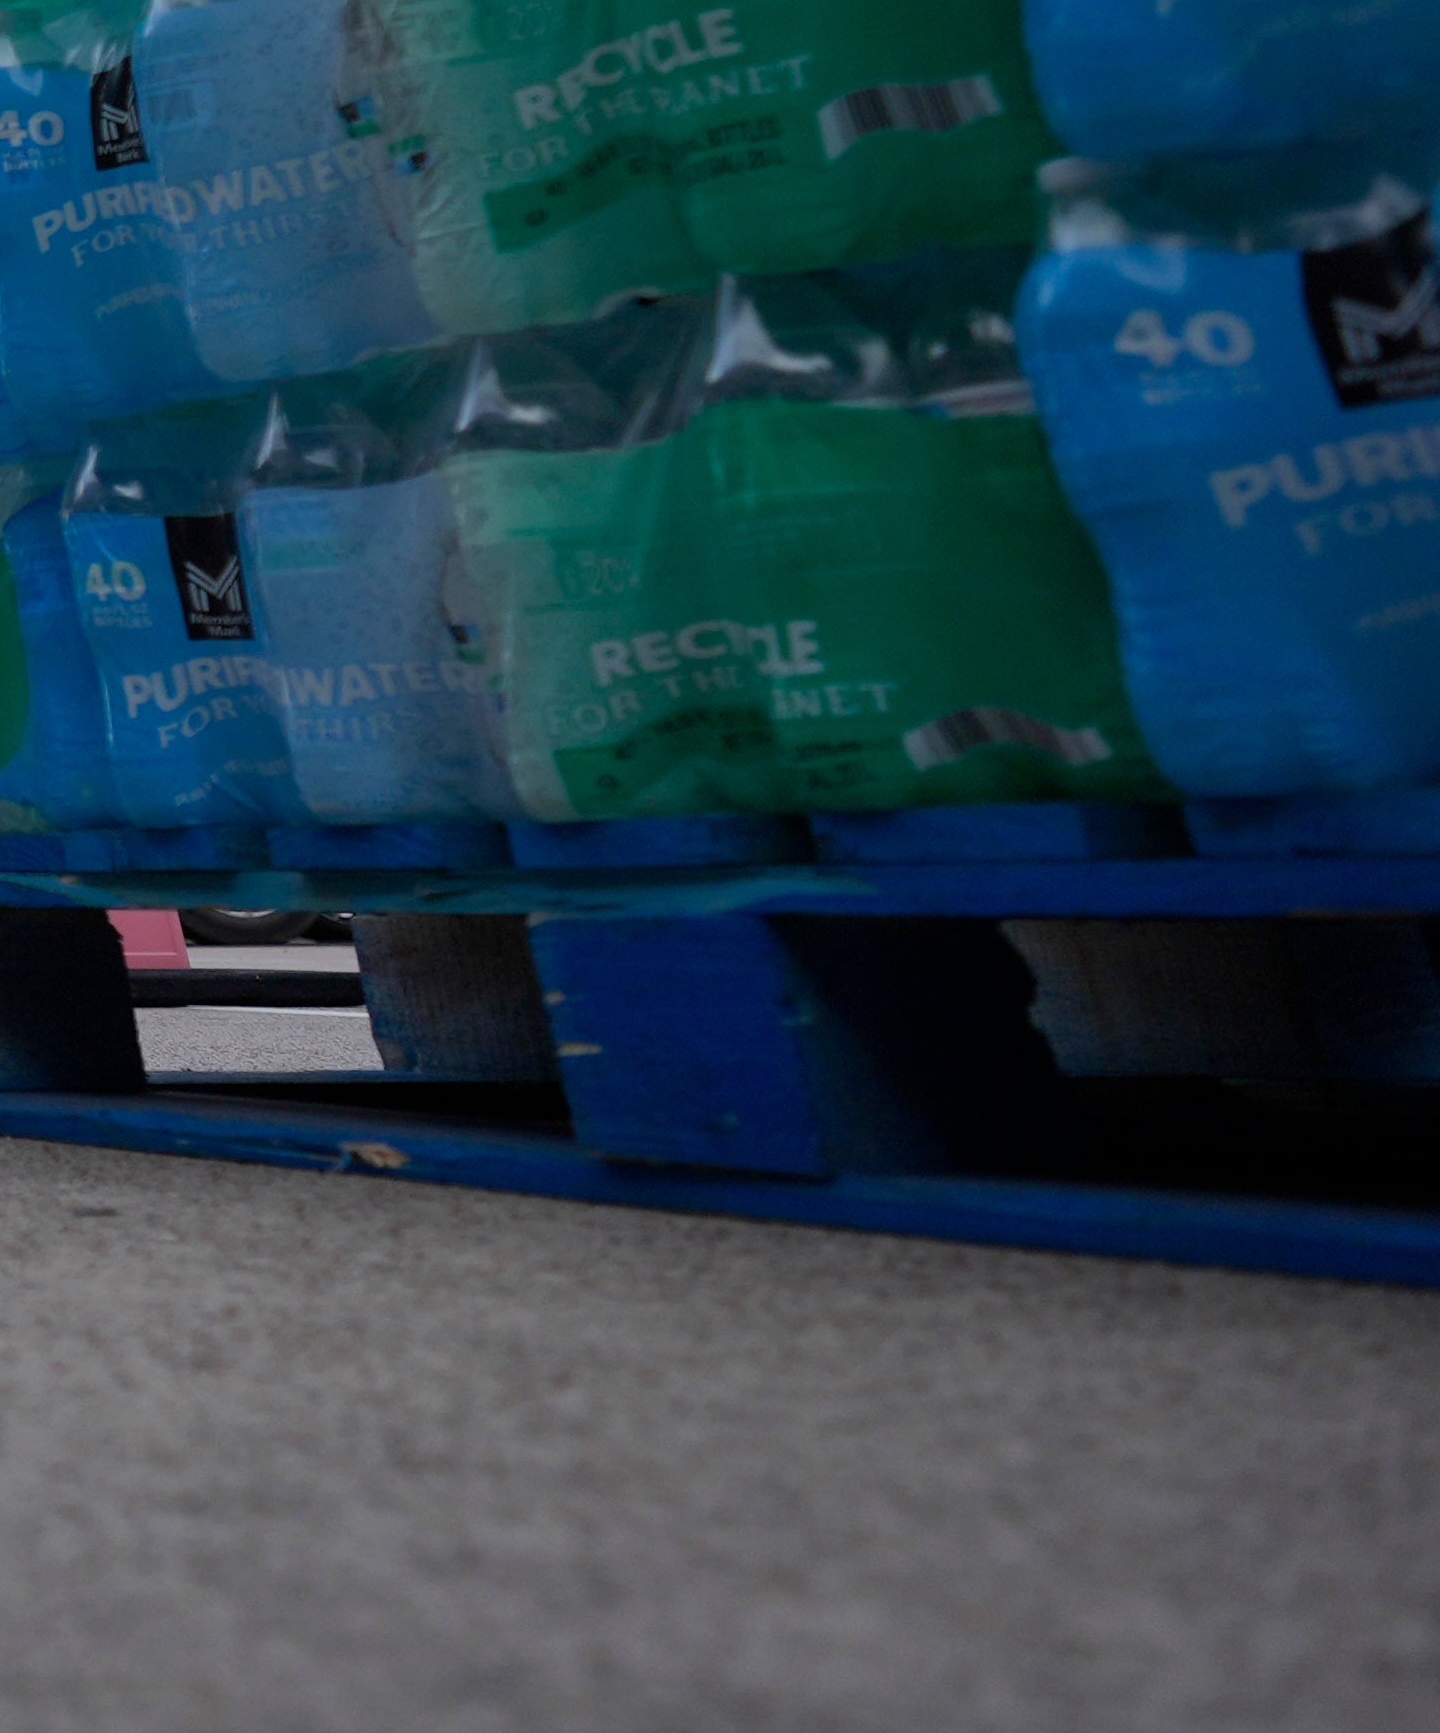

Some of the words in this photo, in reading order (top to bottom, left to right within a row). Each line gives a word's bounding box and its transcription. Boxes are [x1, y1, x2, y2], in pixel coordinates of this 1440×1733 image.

[192, 141, 375, 216] WATER
[479, 135, 568, 180] FOR
[70, 225, 134, 268] FOR
[1113, 309, 1254, 367] 40
[1294, 491, 1440, 556] FOR
[85, 560, 146, 603] 40
[290, 659, 482, 708] WATER
[157, 696, 237, 749] FOR
[546, 690, 643, 737] FOR
